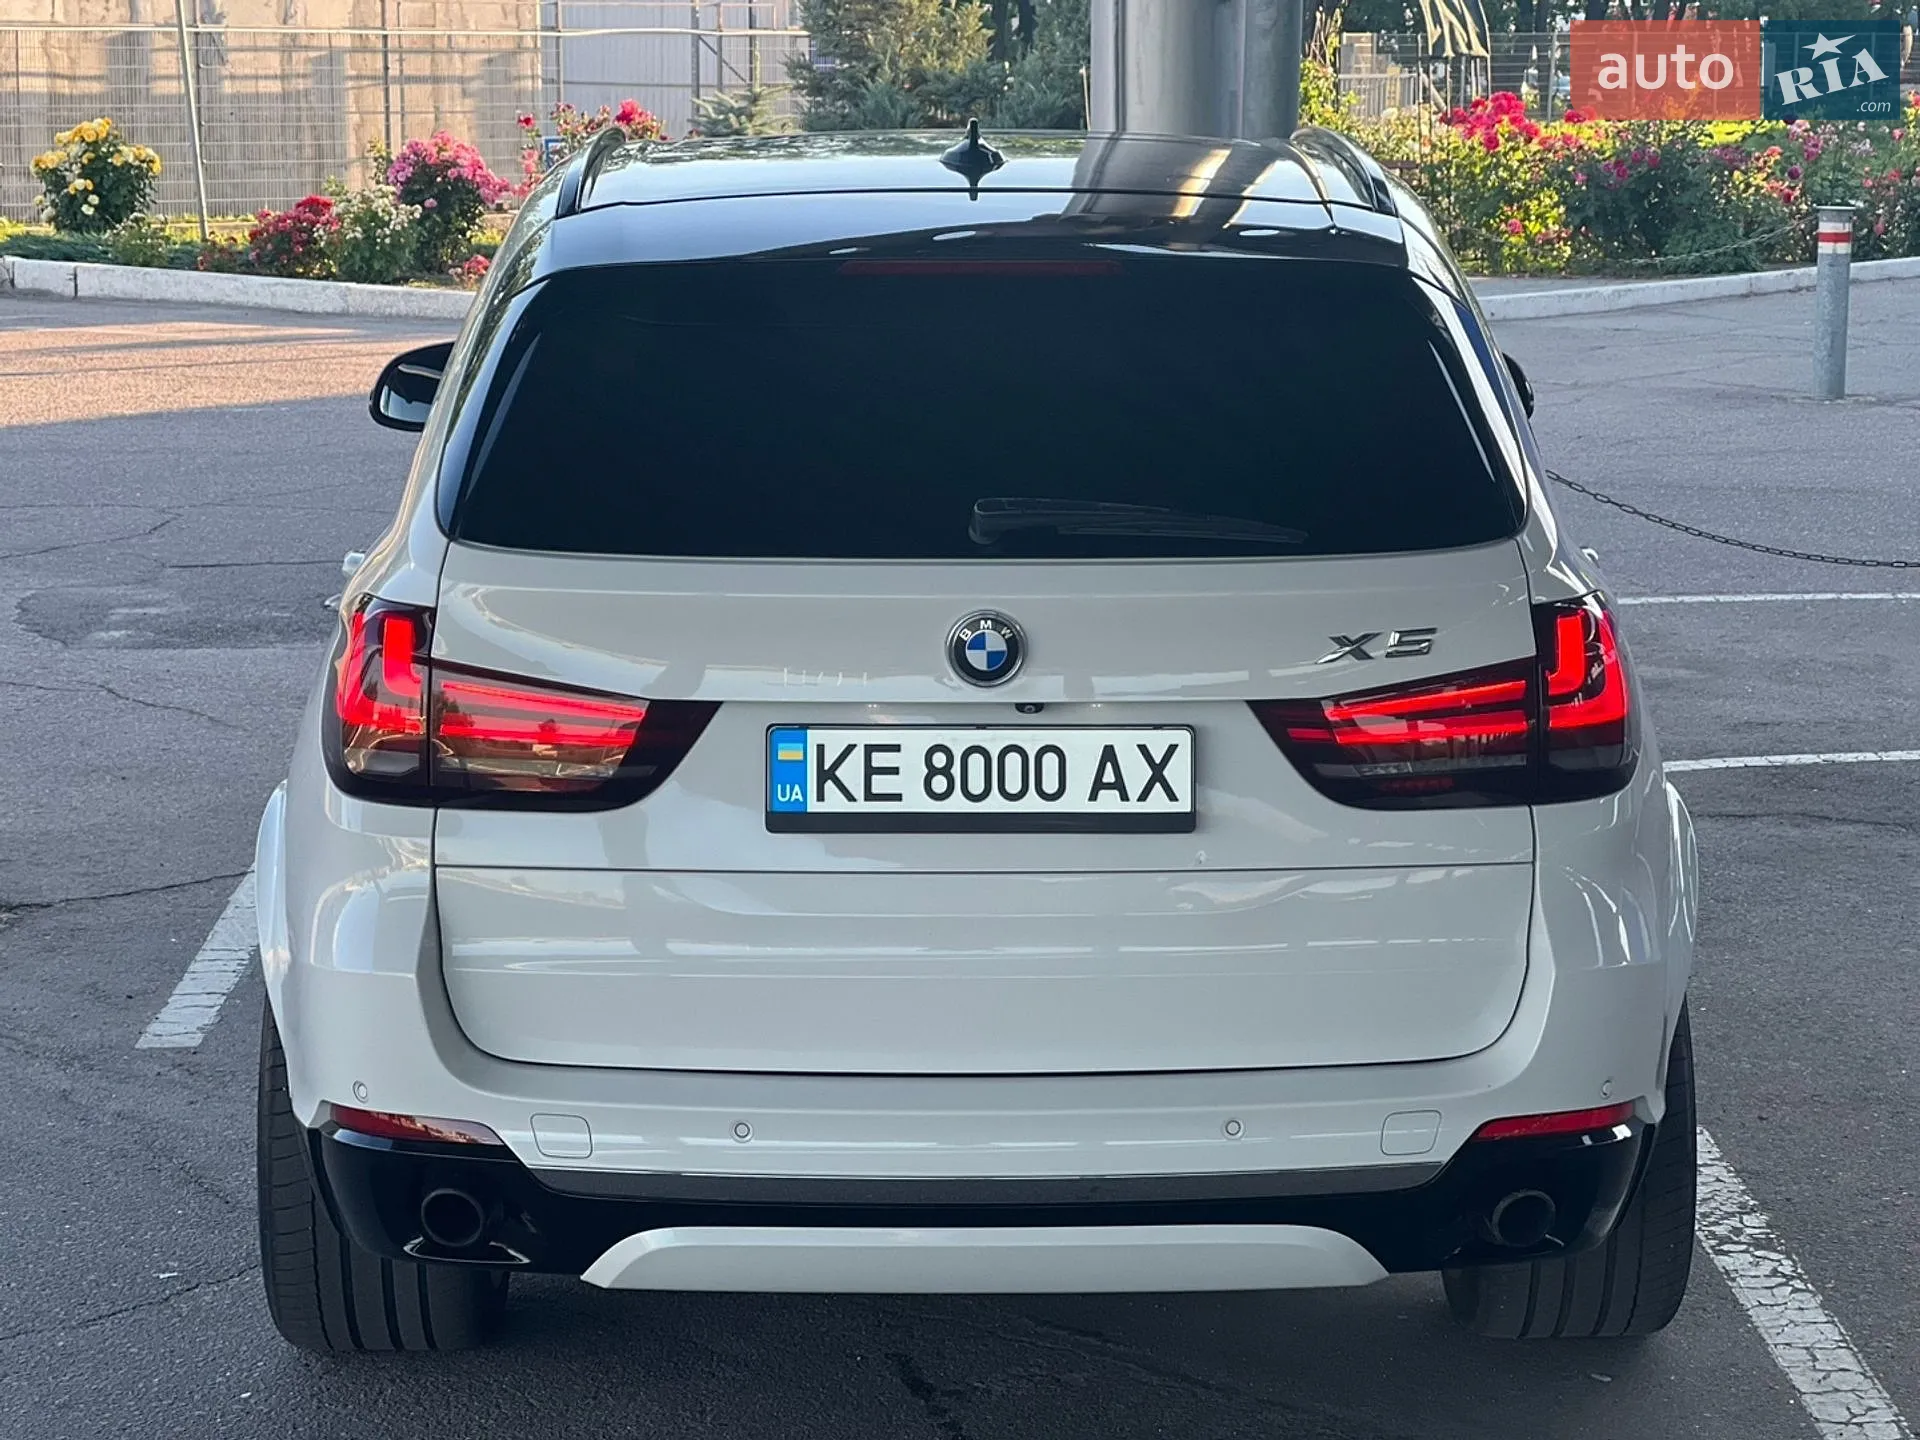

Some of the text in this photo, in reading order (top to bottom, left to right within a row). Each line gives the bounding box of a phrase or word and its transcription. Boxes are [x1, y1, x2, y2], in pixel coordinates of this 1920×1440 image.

[959, 619, 1013, 641] BMW
[1315, 627, 1438, 665] X5
[815, 743, 1180, 803] KE 8000 AX
[777, 784, 804, 802] UA
